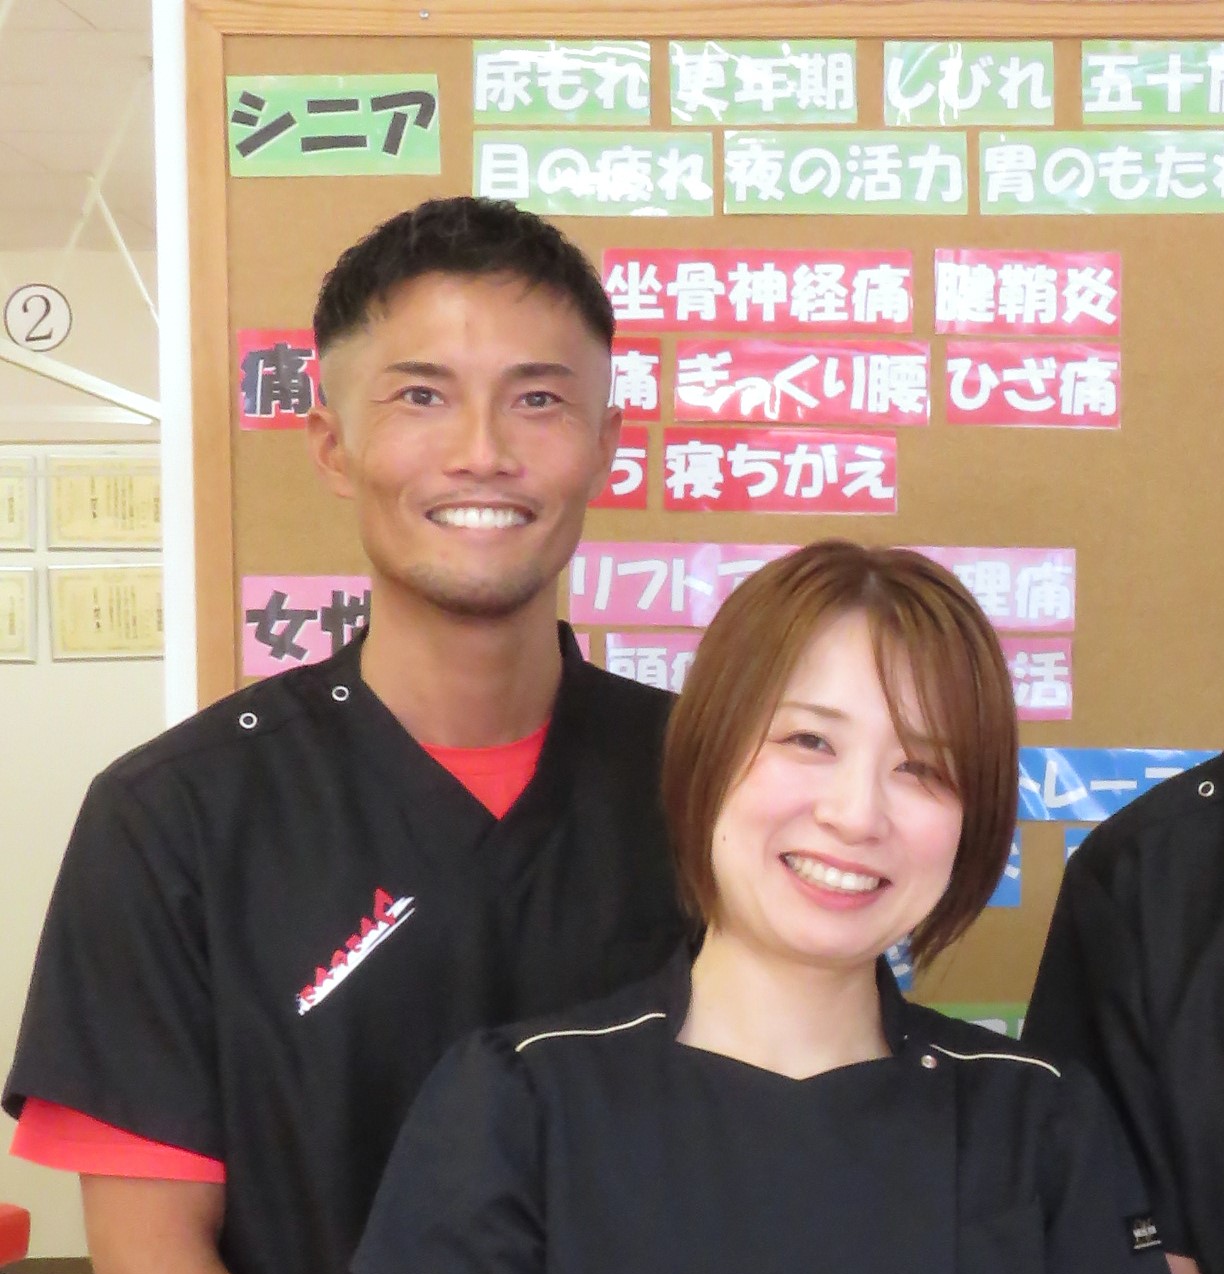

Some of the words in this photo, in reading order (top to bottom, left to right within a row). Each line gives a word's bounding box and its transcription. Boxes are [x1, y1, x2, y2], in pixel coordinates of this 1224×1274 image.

[474, 52, 648, 111] 尿もれ
[673, 53, 854, 111] 更年期
[887, 55, 1051, 112] しびれ
[231, 90, 436, 158] シニア
[479, 143, 712, 202] 目の疲れ
[726, 143, 963, 203] 夜の活力
[605, 262, 911, 323] 坐骨神経痛
[936, 263, 1118, 325] 腱鞘炎
[241, 342, 328, 418] 痛
[677, 352, 929, 417] ぎっくり腰
[947, 356, 1119, 417] ひざ痛
[665, 441, 896, 499] 寝ちがえ
